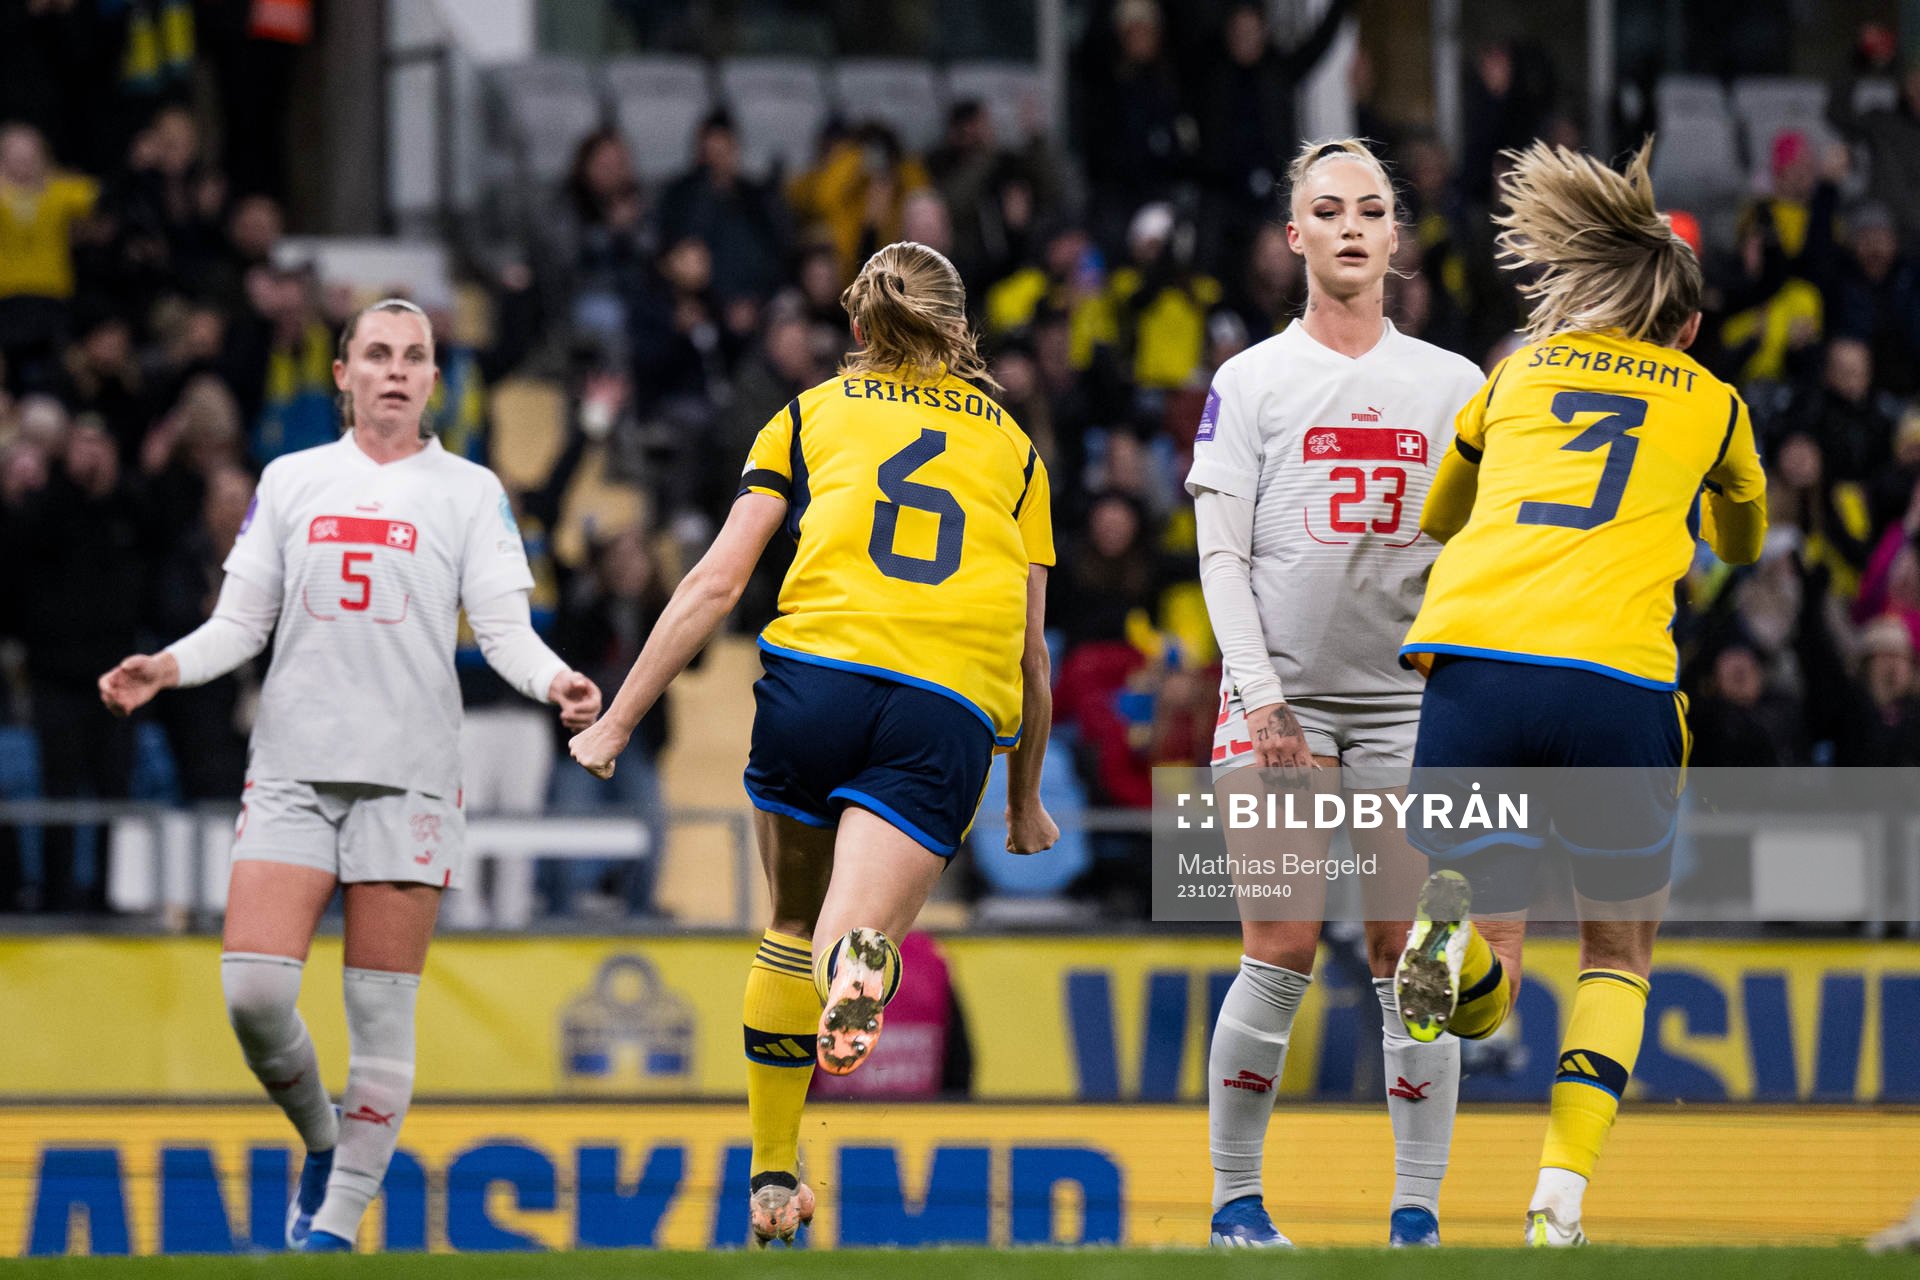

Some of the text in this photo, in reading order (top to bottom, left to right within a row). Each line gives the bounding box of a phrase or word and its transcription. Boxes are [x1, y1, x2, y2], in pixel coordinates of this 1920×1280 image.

[1528, 346, 1698, 392] SEMBRANT
[844, 377, 1003, 427] ERIKSSON
[1351, 412, 1379, 422] PUMA
[1516, 391, 1649, 531] 3
[868, 427, 966, 586] 6
[1329, 467, 1407, 534] 23
[340, 551, 374, 611] 5
[1223, 1078, 1267, 1093] PUMA
